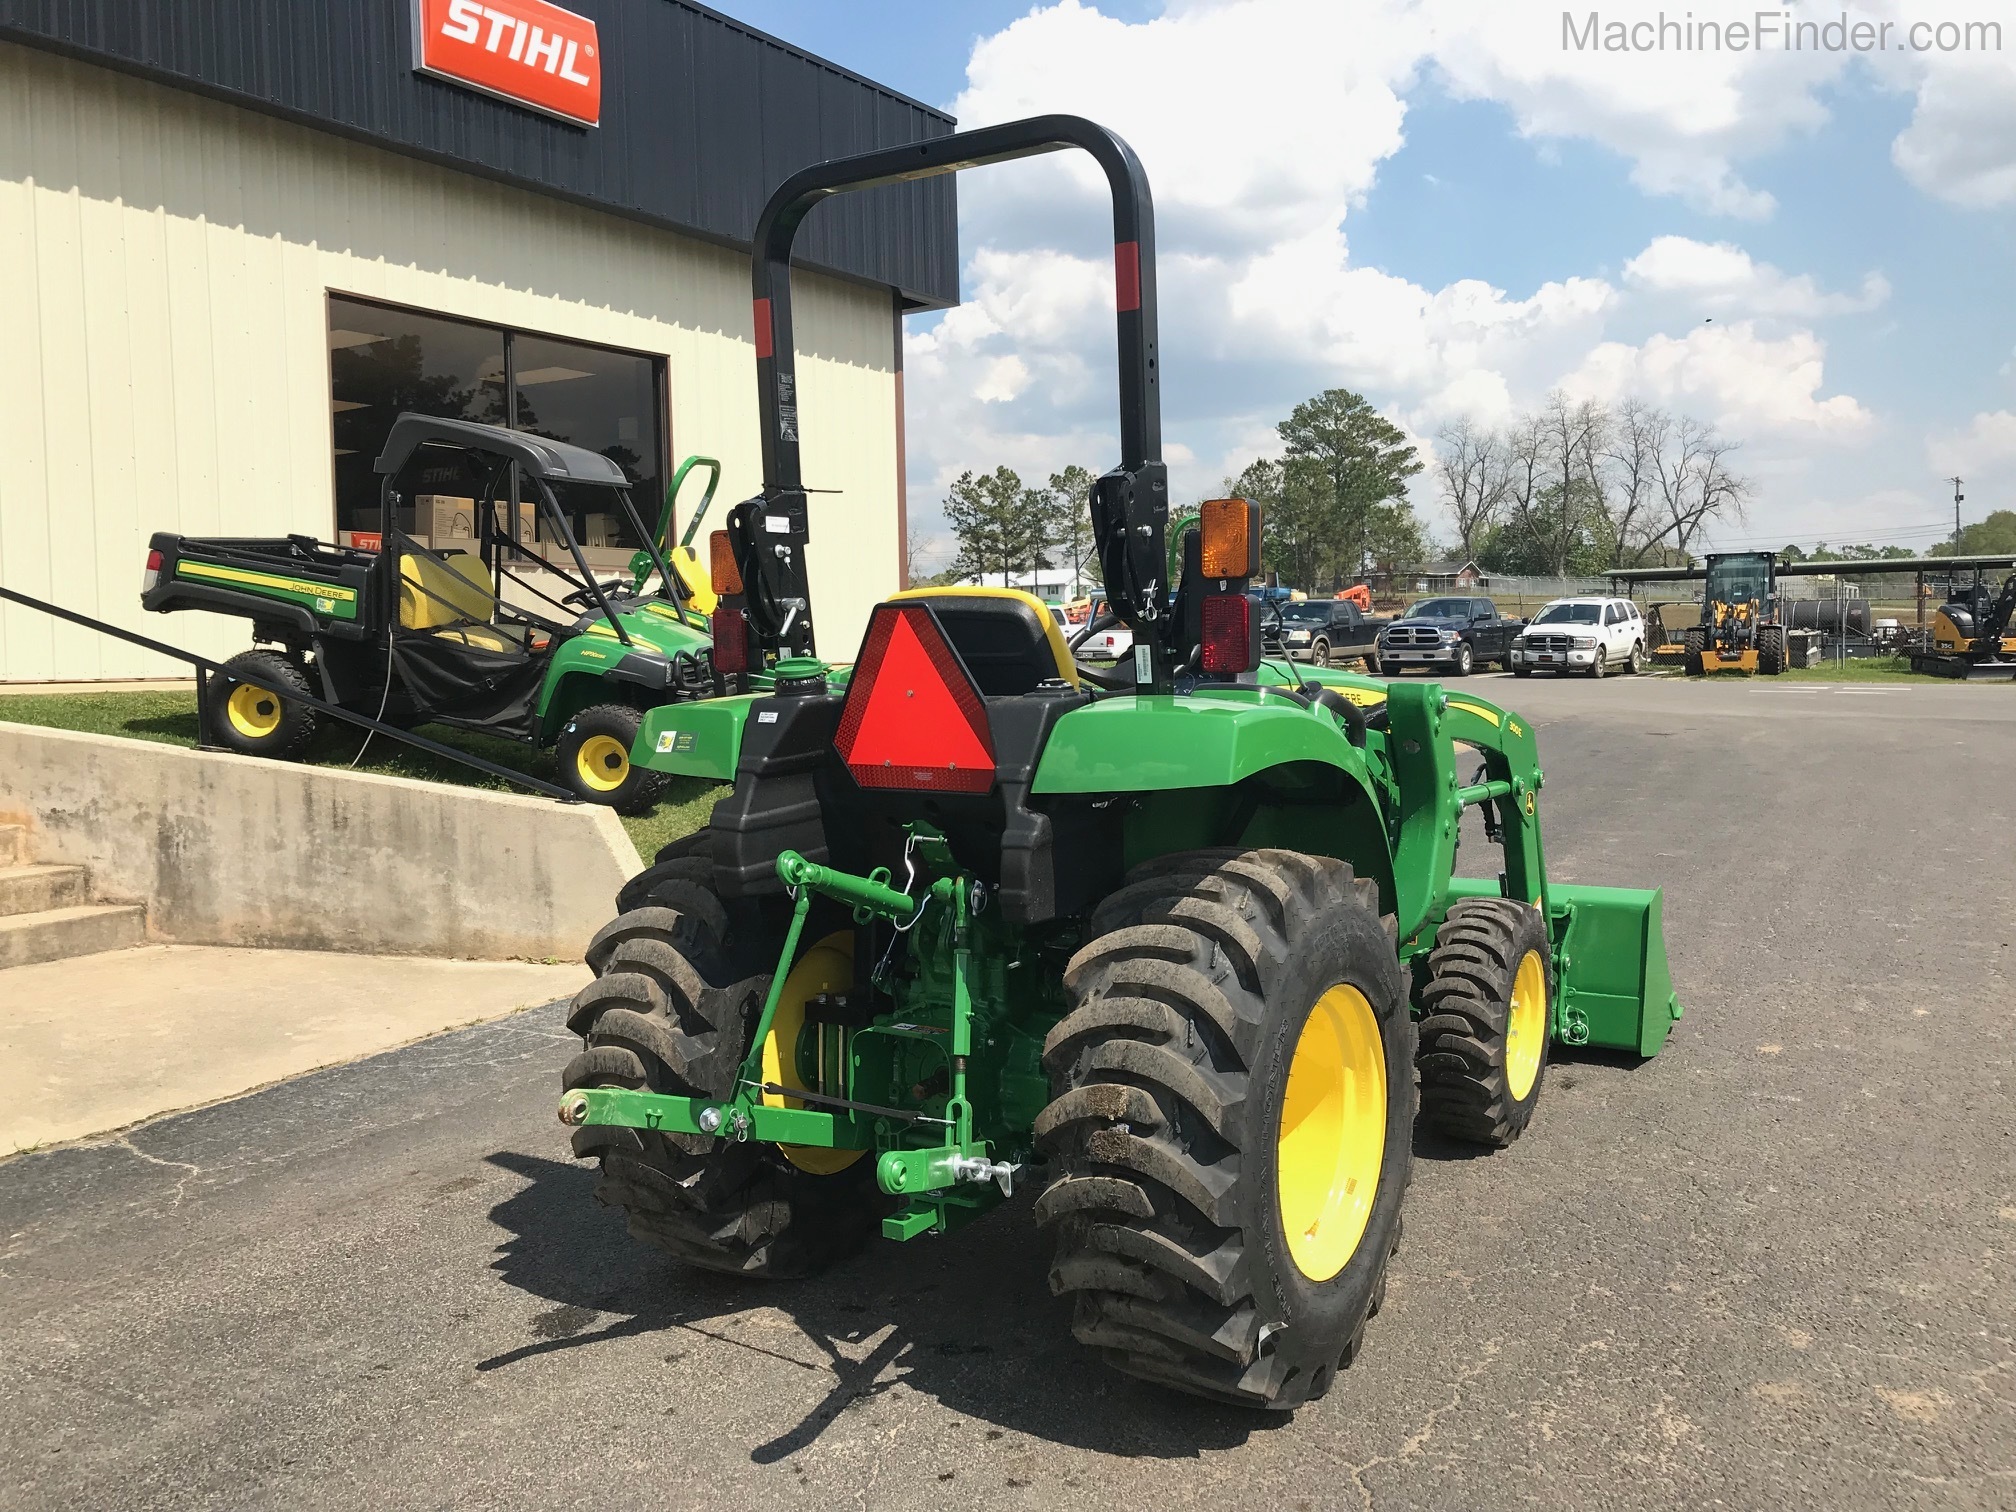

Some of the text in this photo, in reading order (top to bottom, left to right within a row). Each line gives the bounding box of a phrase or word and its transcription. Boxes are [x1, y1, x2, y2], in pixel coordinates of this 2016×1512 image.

[441, 0, 590, 87] STIHL
[290, 583, 344, 599] JOHN DEERE
